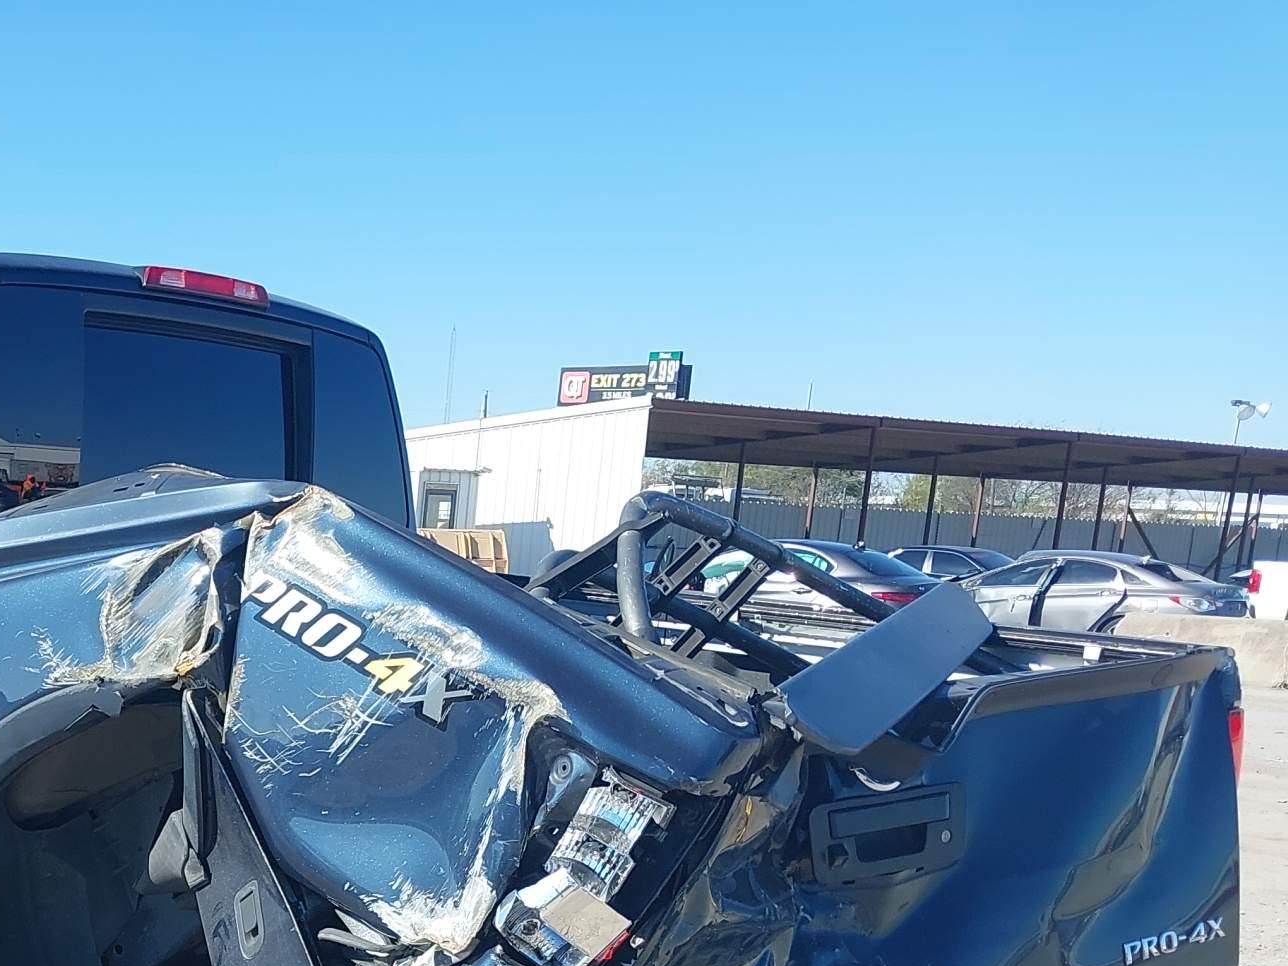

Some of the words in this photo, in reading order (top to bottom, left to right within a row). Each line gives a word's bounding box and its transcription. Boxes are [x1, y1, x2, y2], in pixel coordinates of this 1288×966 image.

[591, 373, 620, 388] EXIT
[621, 372, 647, 388] 273
[240, 573, 474, 724] PRO-4X
[1123, 917, 1226, 966] PRO-4X
